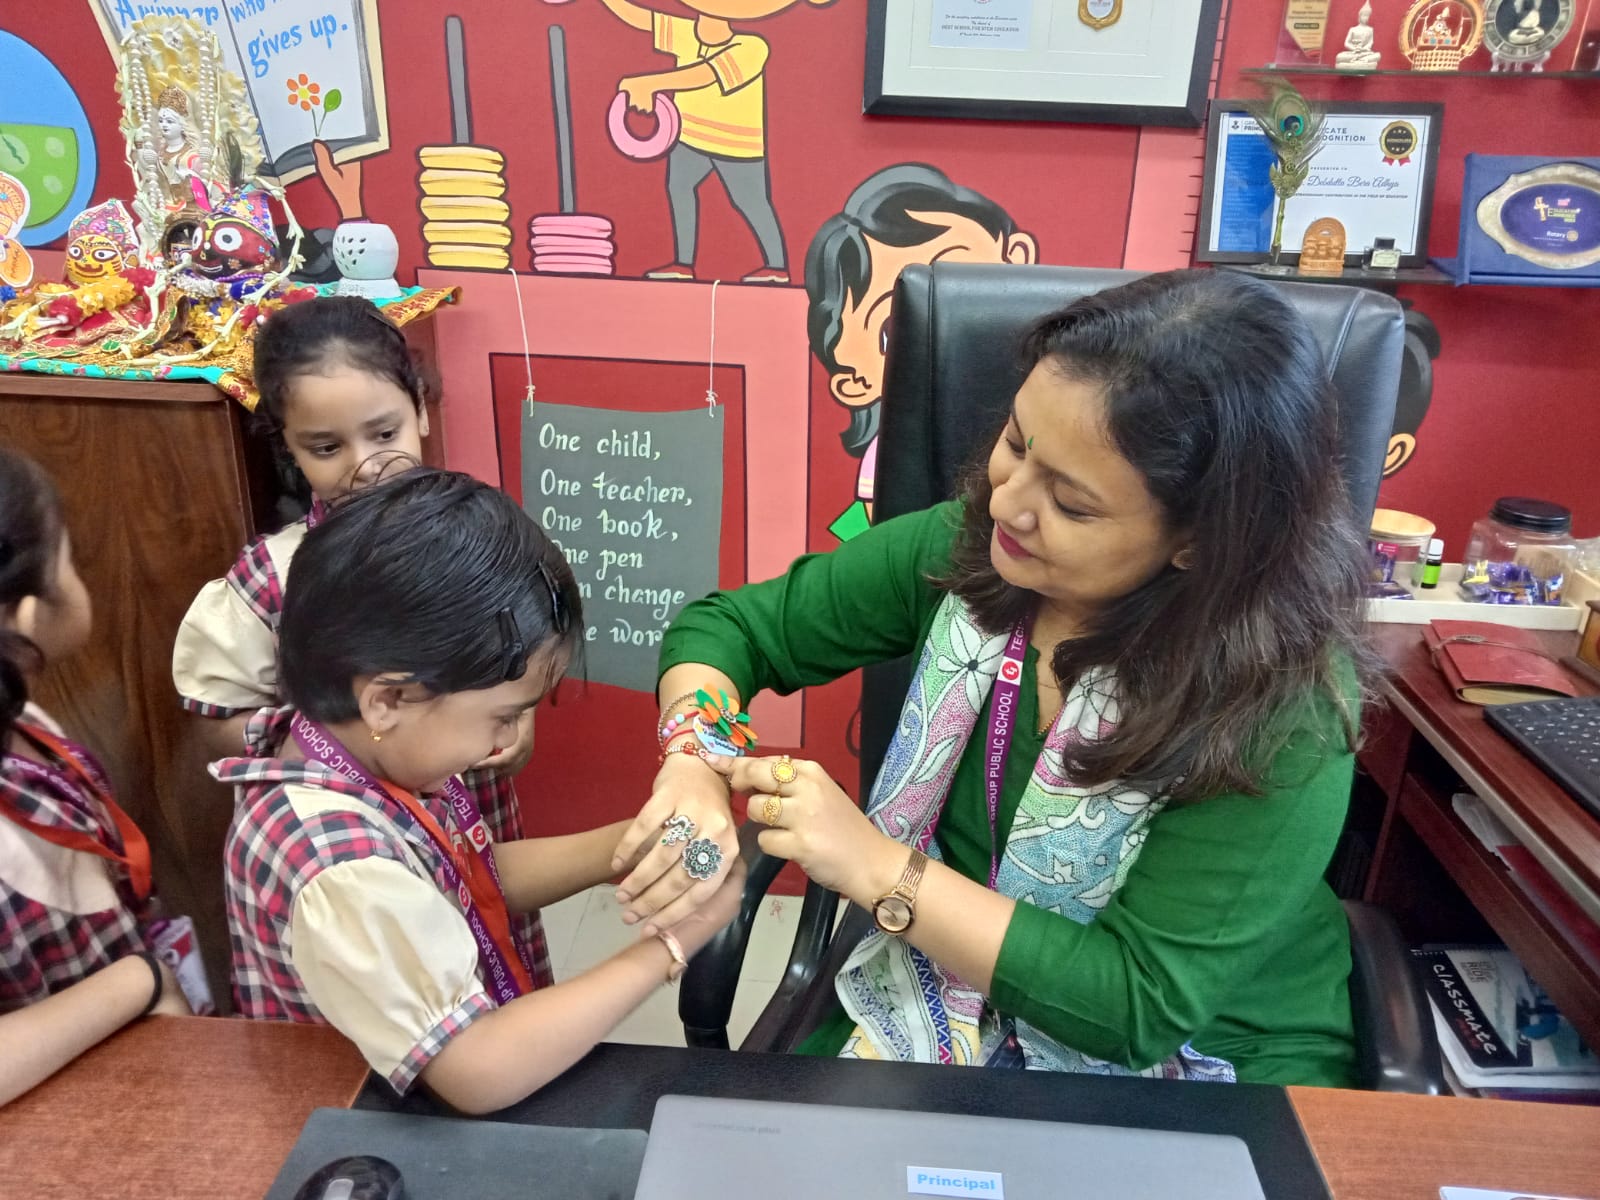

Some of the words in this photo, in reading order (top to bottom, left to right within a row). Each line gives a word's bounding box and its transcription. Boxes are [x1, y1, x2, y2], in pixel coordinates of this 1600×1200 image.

[248, 25, 303, 79] gives
[539, 422, 581, 452] One
[597, 429, 661, 461] child,
[540, 468, 582, 496] One
[591, 471, 693, 506] teacher,
[542, 505, 583, 531] One
[597, 508, 679, 542] book,
[596, 548, 645, 581] pen
[604, 575, 686, 620] change
[994, 689, 1014, 736] SCHOOL
[989, 738, 1006, 778] PUBLIC
[471, 910, 493, 956] SCHOOL
[489, 951, 508, 990] PUBLIC
[917, 1173, 996, 1192] Principal
